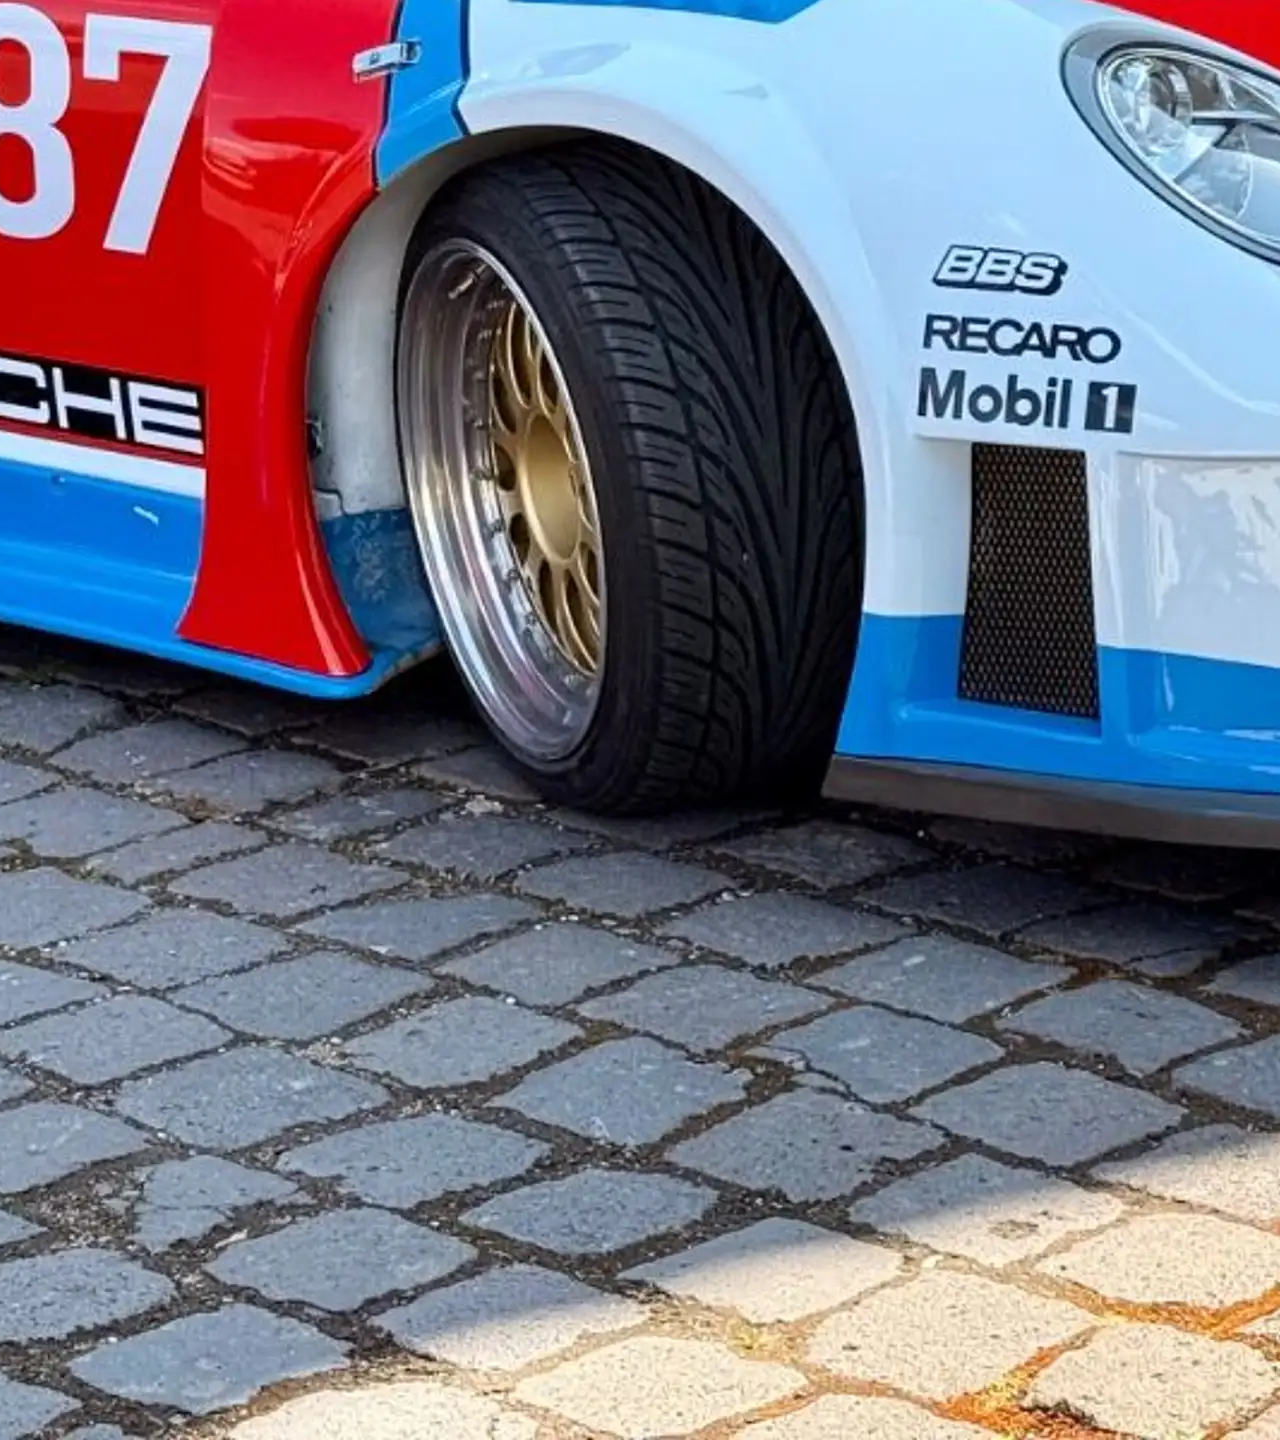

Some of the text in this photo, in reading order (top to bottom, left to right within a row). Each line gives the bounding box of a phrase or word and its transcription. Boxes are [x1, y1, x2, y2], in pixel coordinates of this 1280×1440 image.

[932, 244, 1068, 296] BBS
[922, 313, 1123, 364] RECARO
[916, 366, 1073, 429] Mobil
